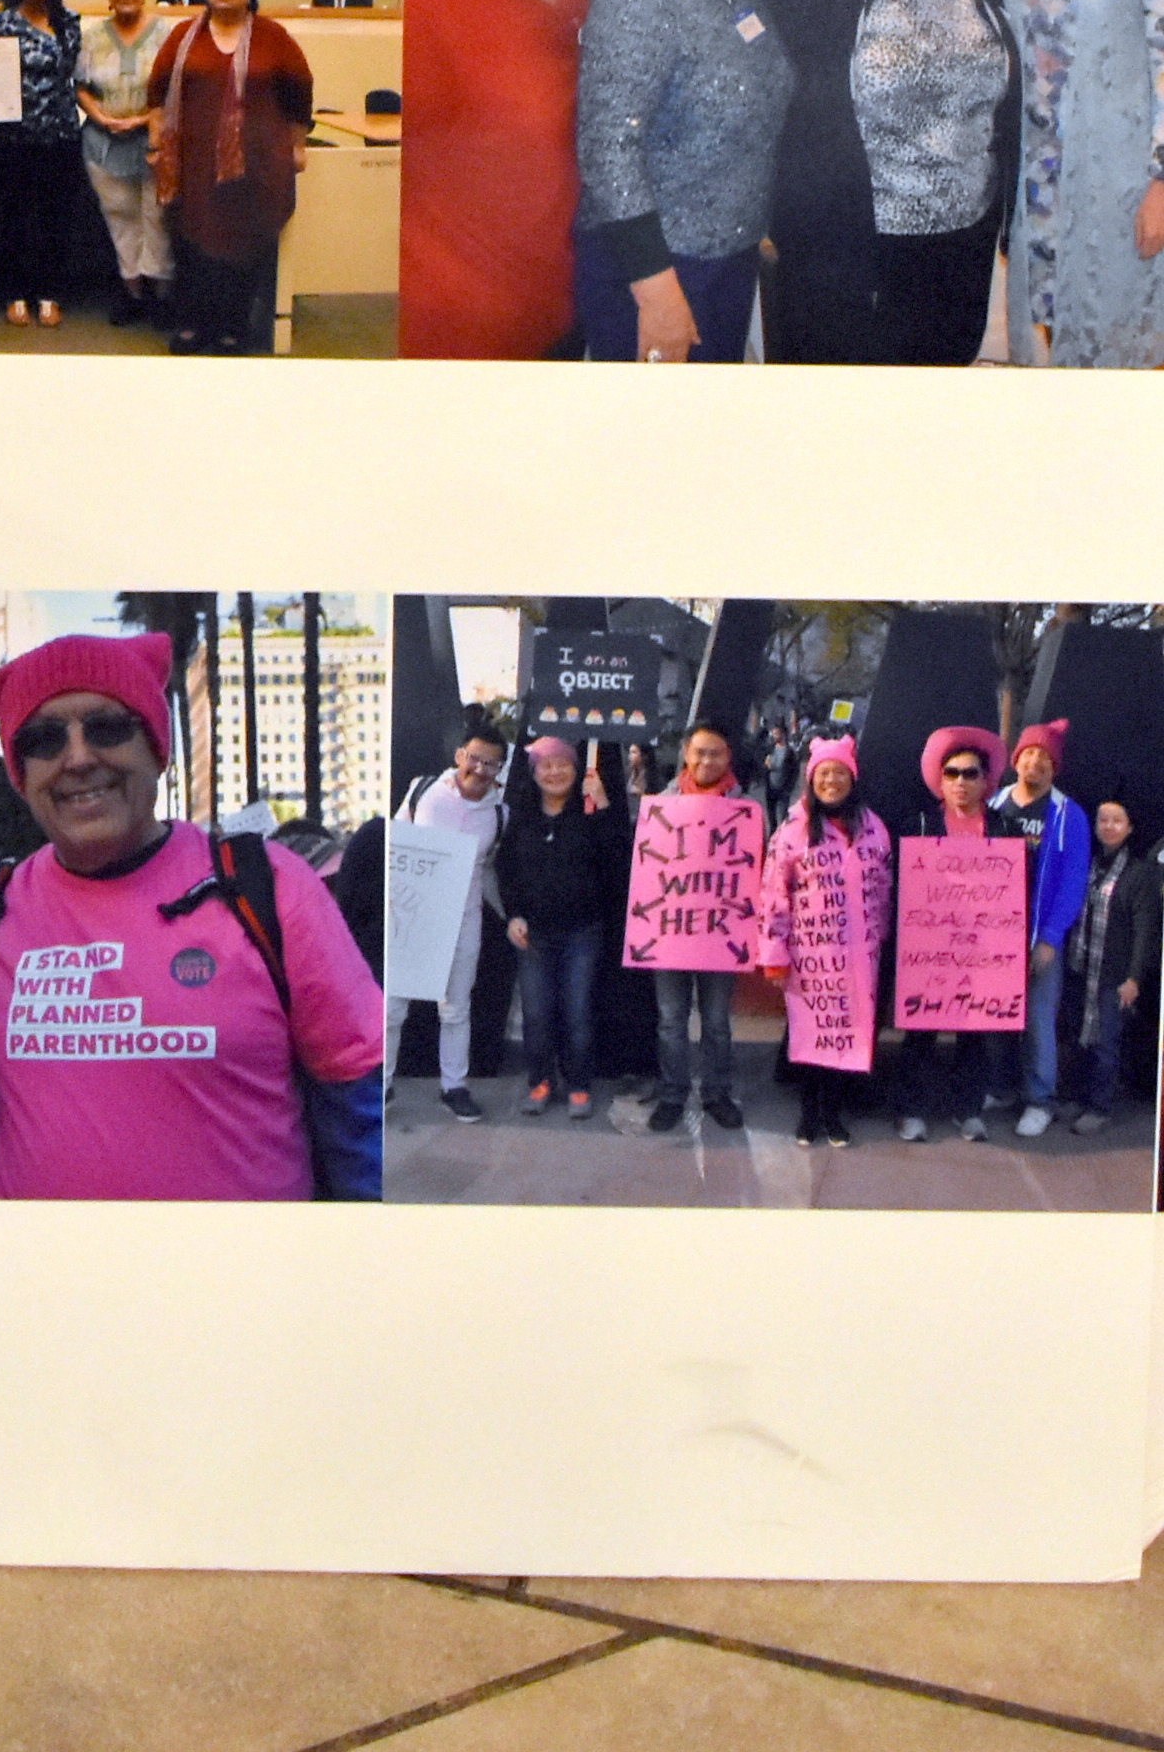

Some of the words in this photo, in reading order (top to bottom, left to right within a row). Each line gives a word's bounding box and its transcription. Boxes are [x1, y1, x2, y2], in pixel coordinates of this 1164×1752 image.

[558, 646, 574, 666] I
[659, 870, 739, 898] WITH
[927, 884, 1009, 903] WITHOUT
[660, 907, 731, 936] HER
[20, 955, 30, 970] I
[36, 947, 117, 970] STAND
[17, 976, 86, 996] WITH
[803, 995, 849, 1011] VOTE
[904, 992, 1023, 1019] SHITHOLE
[10, 1003, 137, 1025] PLANNED
[816, 1014, 852, 1029] LOVE
[9, 1031, 209, 1054] PARENTHOOD
[815, 1034, 855, 1051] ANOT
